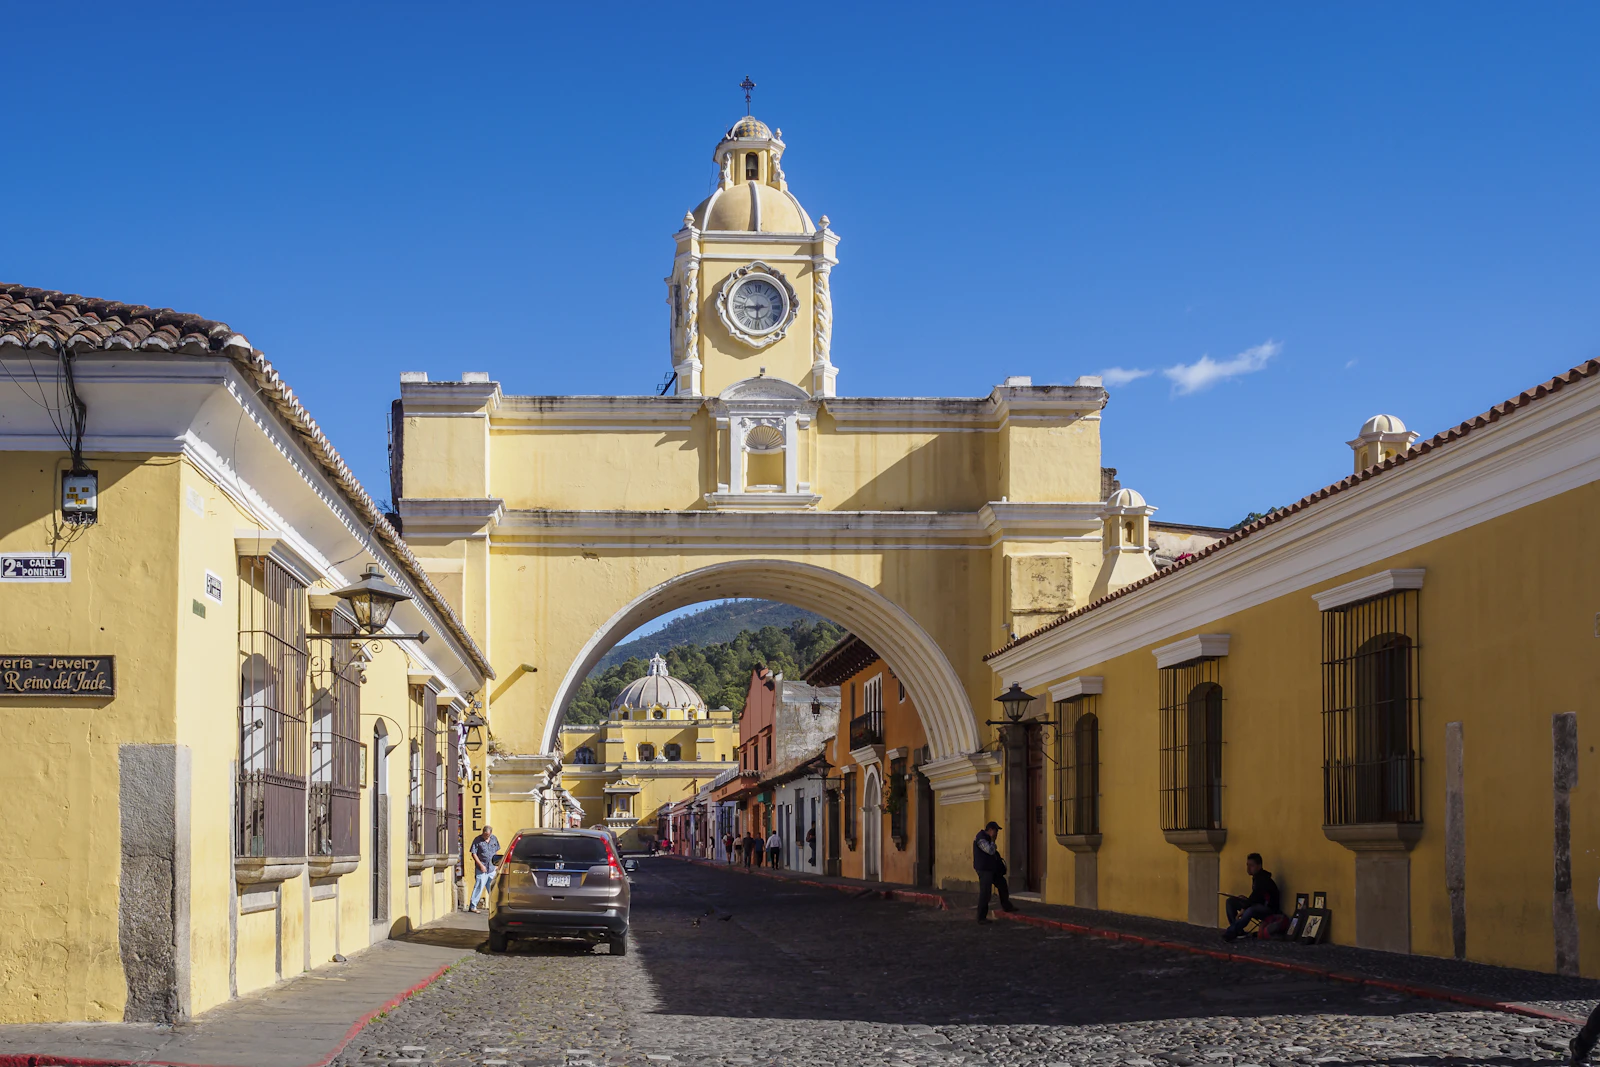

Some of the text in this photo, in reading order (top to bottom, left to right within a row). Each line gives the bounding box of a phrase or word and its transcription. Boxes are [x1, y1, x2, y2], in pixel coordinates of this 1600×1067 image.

[49, 658, 100, 671] Jewelry
[4, 670, 107, 692] Reino del Jade
[472, 770, 482, 831] HOTEL
